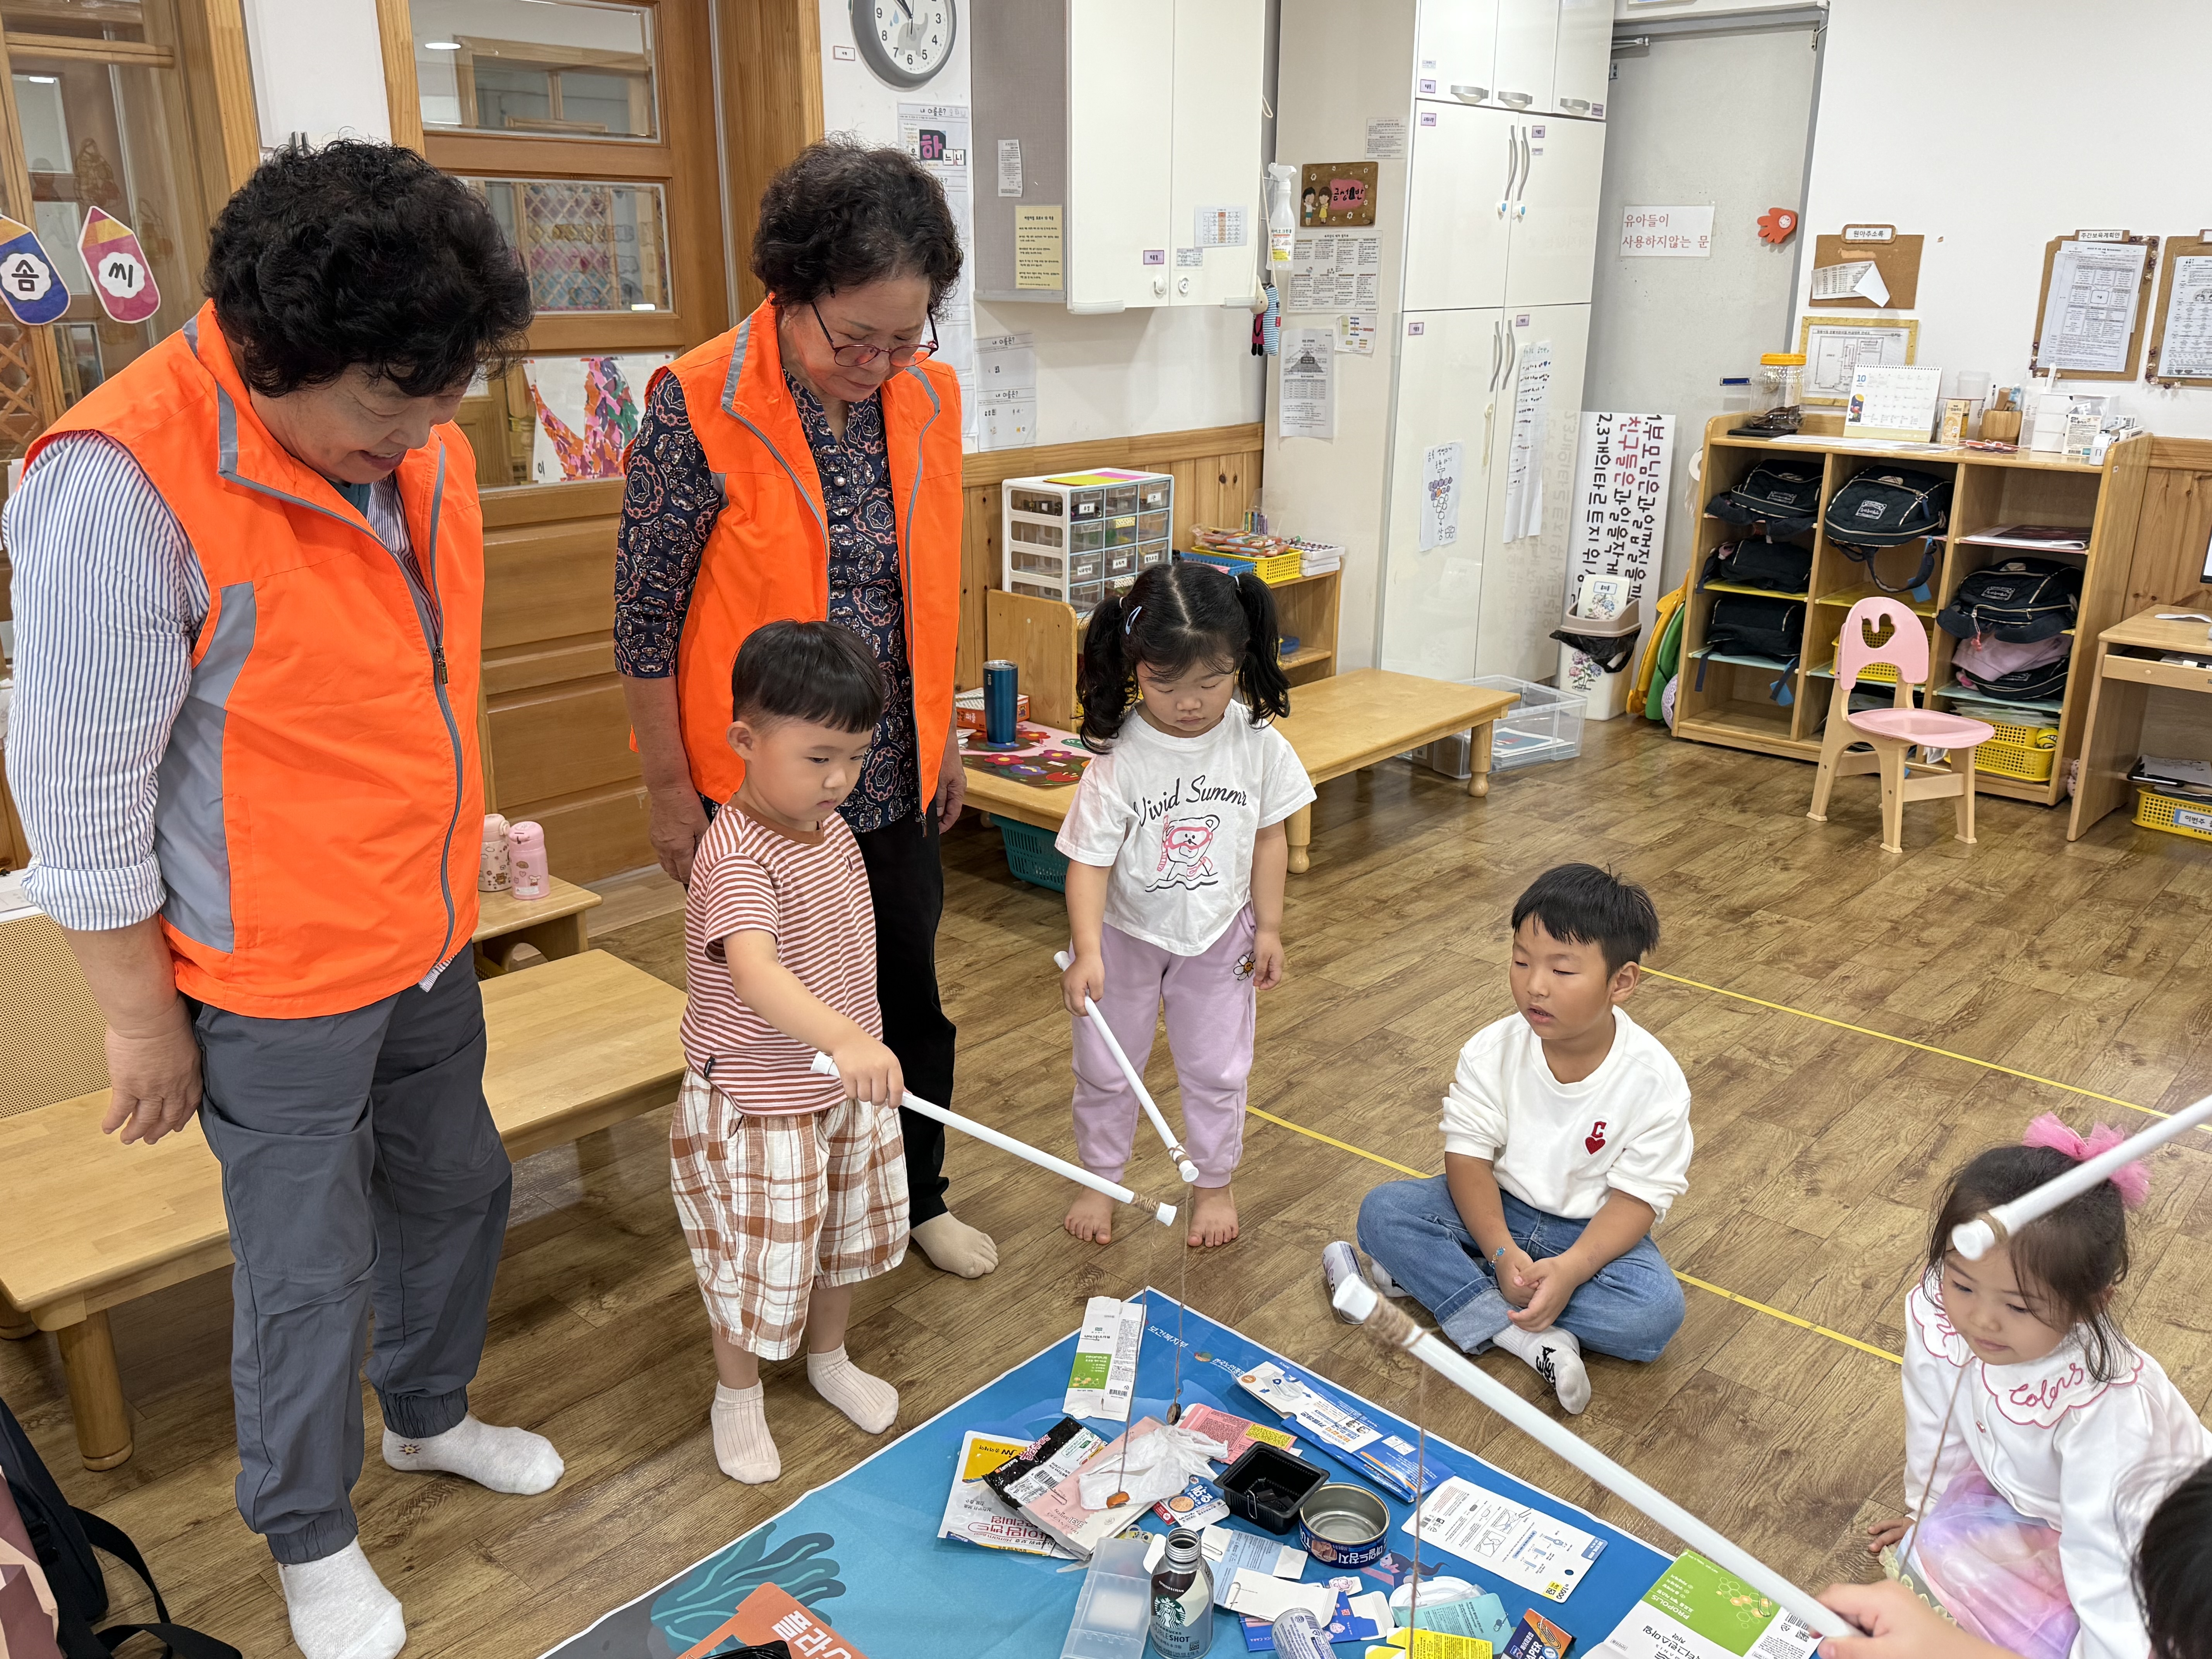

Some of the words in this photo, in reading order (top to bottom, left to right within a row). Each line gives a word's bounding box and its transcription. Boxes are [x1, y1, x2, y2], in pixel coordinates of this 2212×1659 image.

[876, 8, 882, 18] 9
[936, 14, 941, 24] 3
[882, 31, 887, 41] 8
[932, 35, 937, 45] 4
[893, 48, 898, 58] 7
[907, 54, 913, 64] 6
[922, 50, 927, 60] 5
[920, 134, 943, 159] 하
[1624, 214, 1669, 227] 유아들이
[1622, 235, 1691, 248] 사용하지않는
[1698, 235, 1709, 248] 문
[11, 259, 40, 292] 솜
[108, 262, 134, 288] 씨
[2185, 816, 2205, 824] 이번주
[1147, 1322, 1188, 1352] 보건복지부
[977, 1522, 1003, 1534] 밴드
[1338, 1546, 1384, 1565] 마일드참치
[1649, 1594, 1691, 1620] PROPOLIS
[1671, 1632, 1686, 1644] 치약
